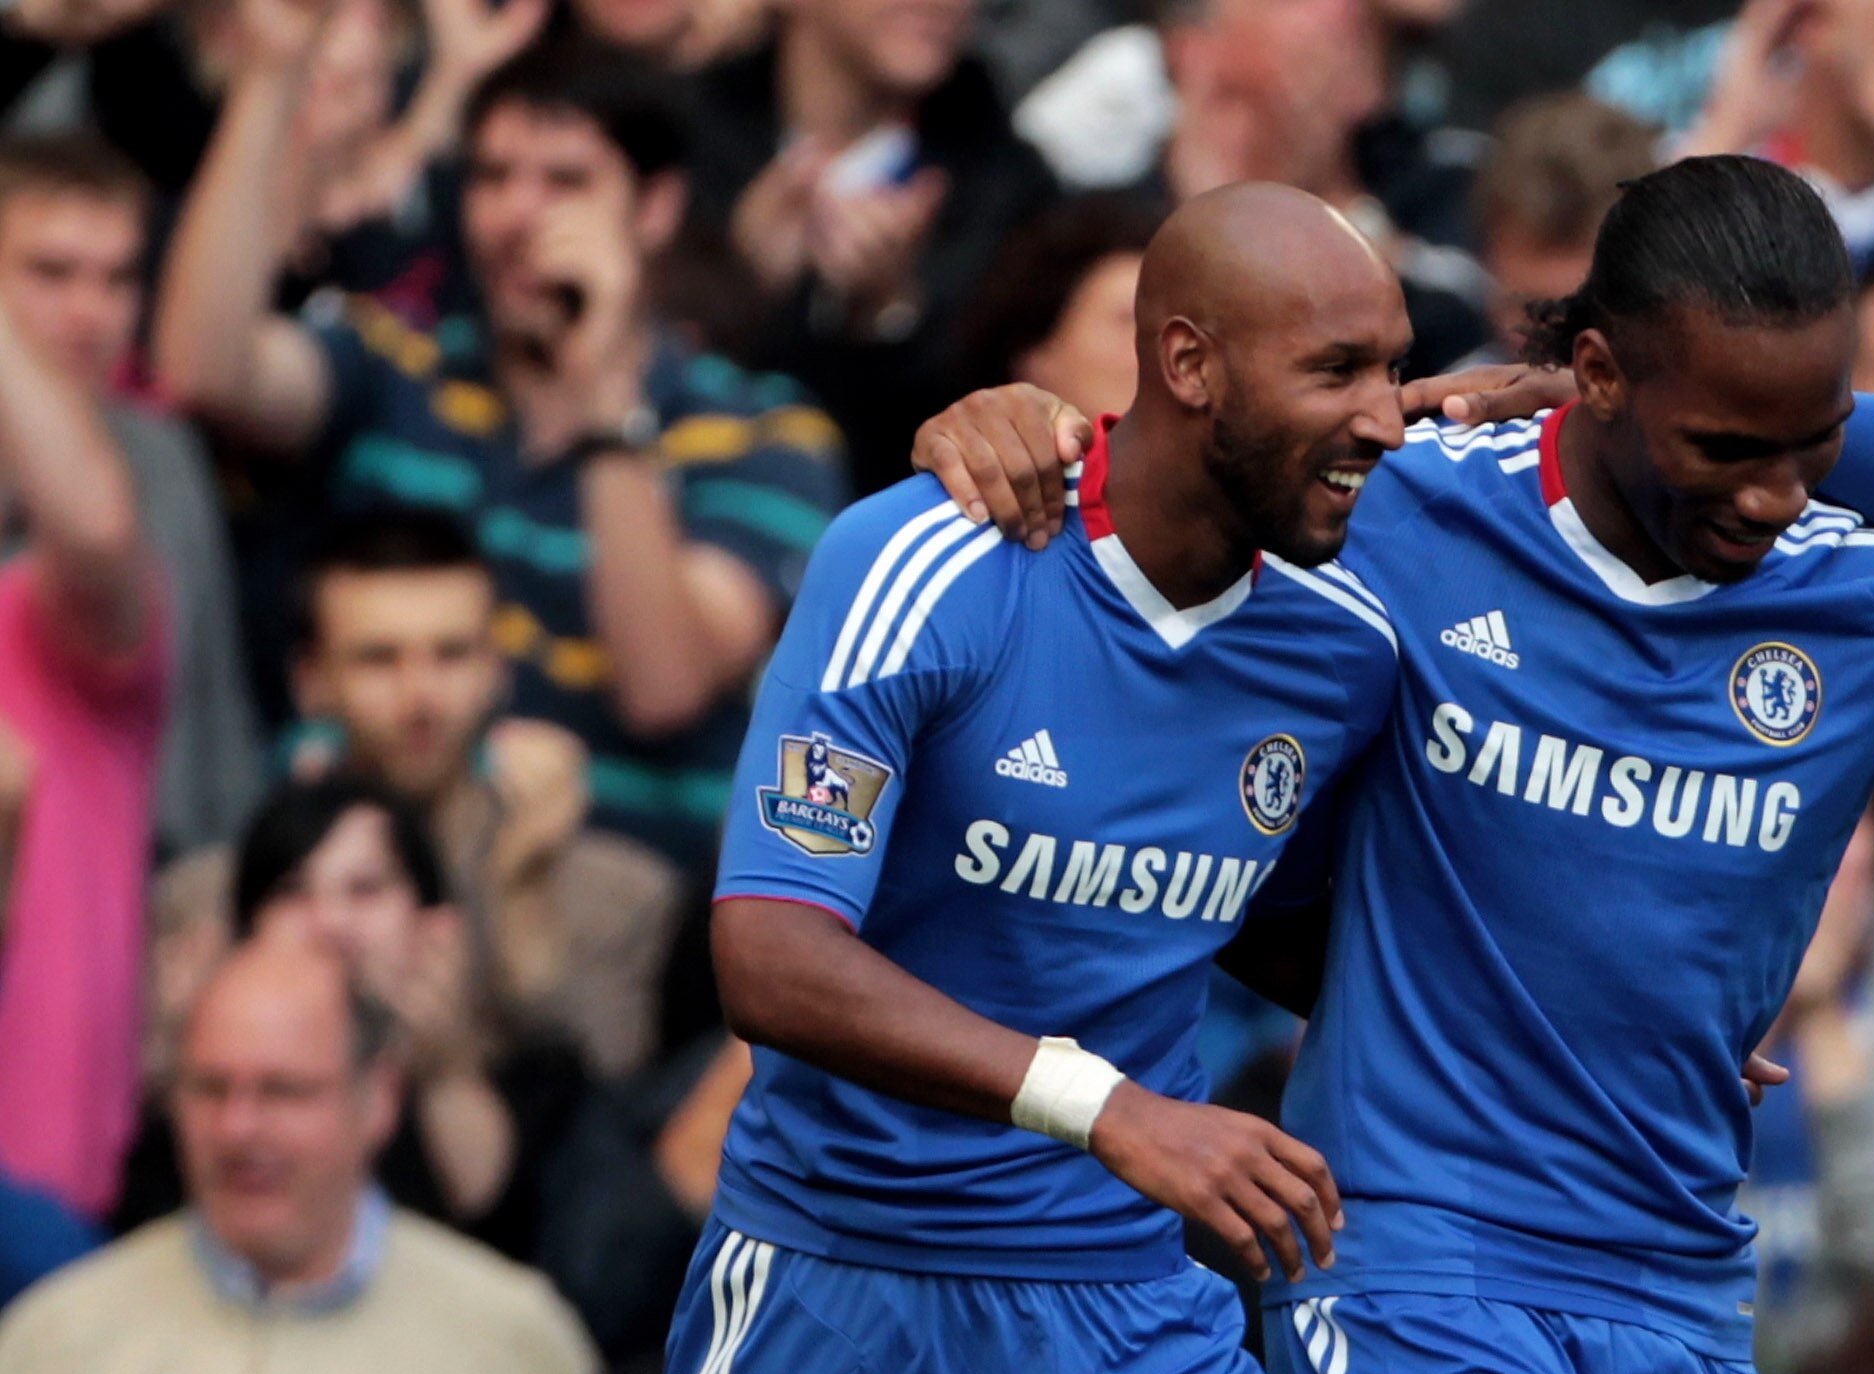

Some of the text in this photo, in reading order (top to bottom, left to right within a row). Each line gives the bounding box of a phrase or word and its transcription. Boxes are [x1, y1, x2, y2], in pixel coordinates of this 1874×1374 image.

[1440, 625, 1519, 669] adidas
[1747, 649, 1804, 671] CHELSEA
[995, 758, 1067, 788] adidas
[1426, 703, 1801, 853] SAMSUNG
[777, 800, 849, 831] BARCLAYS
[954, 820, 1276, 923] SAMSUN
